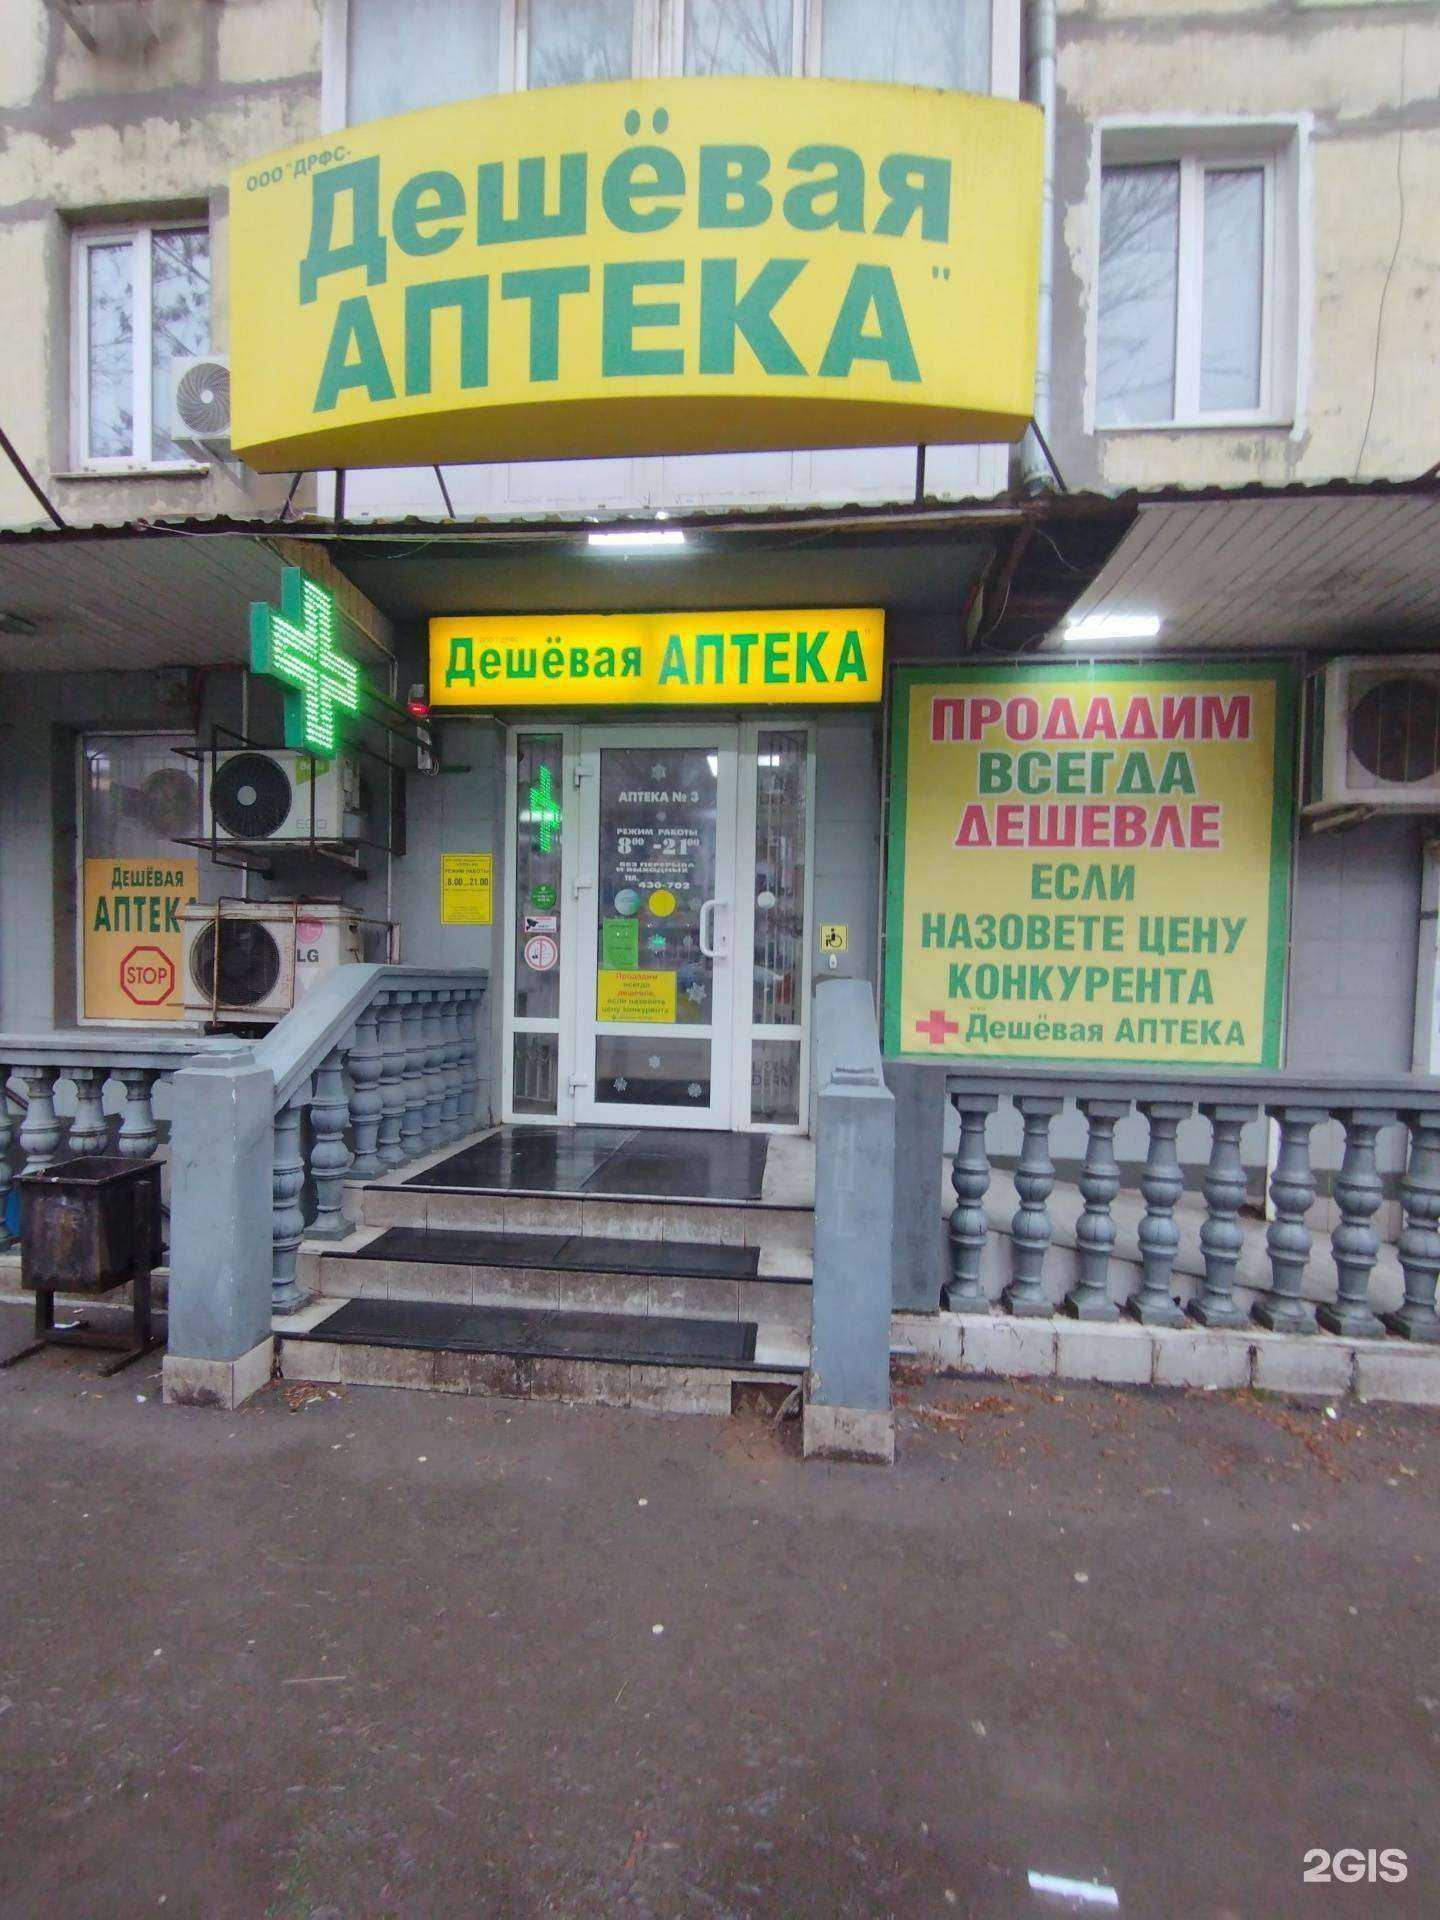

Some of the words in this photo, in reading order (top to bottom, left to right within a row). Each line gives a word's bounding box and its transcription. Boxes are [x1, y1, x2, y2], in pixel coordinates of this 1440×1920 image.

[246, 166, 283, 192] ООО
[299, 107, 952, 306] Дешёвая
[445, 636, 642, 688] Дешёвая
[931, 695, 1253, 741] ПРОДАДИМ
[978, 751, 1197, 794] ВСЕГДА
[619, 791, 669, 803] АПТЕКА
[672, 791, 687, 803] №
[690, 791, 699, 803] 3
[954, 804, 1221, 848] ДЕШЕВЛЕ
[638, 881, 690, 890] 430-702
[1030, 862, 1136, 901] ЕСЛИ
[93, 896, 197, 933] АПТЕК
[920, 913, 1124, 952] НАЗОВЕТЕ
[1138, 916, 1247, 956] ЦЕНУ
[296, 948, 319, 962] LG
[127, 966, 167, 985] STOP
[947, 963, 1214, 1005] КОНКУРЕНТА
[965, 1013, 1104, 1044] Дешёвая
[1114, 1017, 1245, 1046] АПТЕКА
